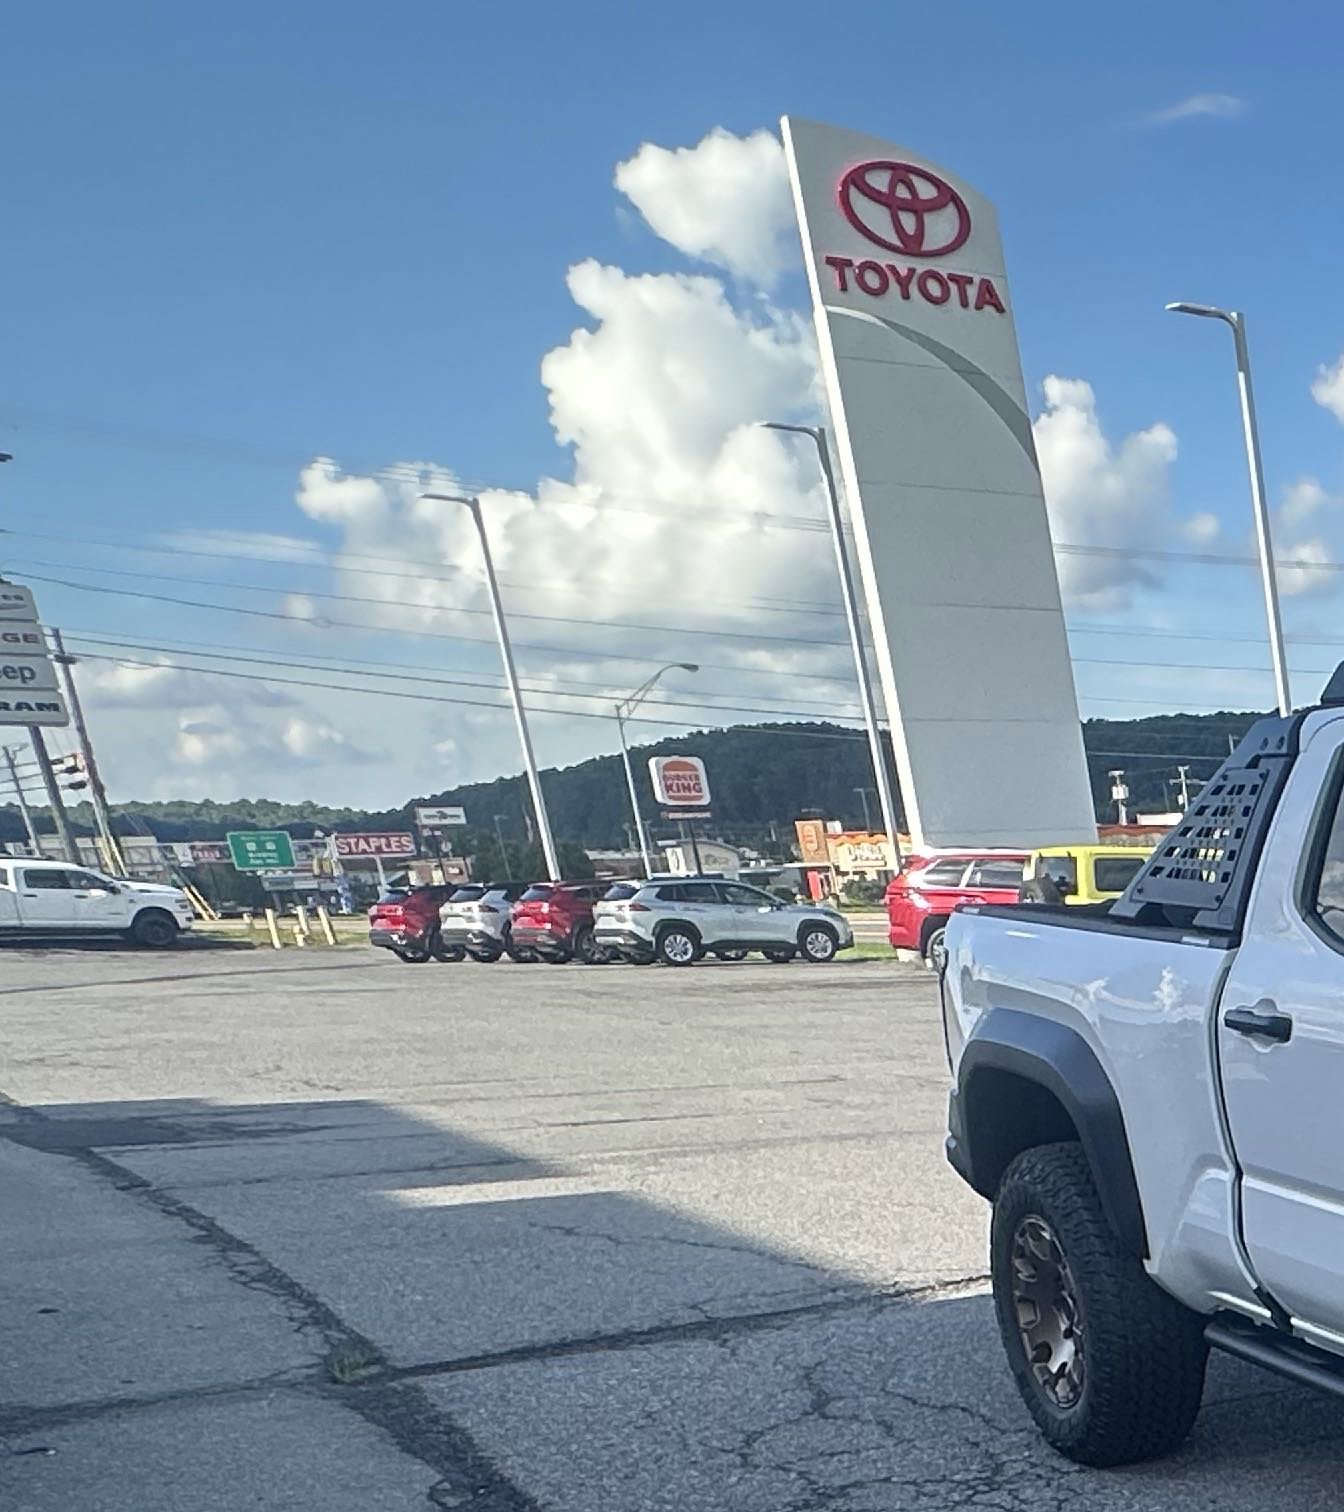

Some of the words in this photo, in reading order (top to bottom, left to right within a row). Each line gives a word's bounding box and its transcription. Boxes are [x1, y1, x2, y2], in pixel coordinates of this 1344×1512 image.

[825, 255, 1006, 314] TOYOTA
[664, 782, 703, 794] KING
[335, 836, 416, 854] STAPLES
